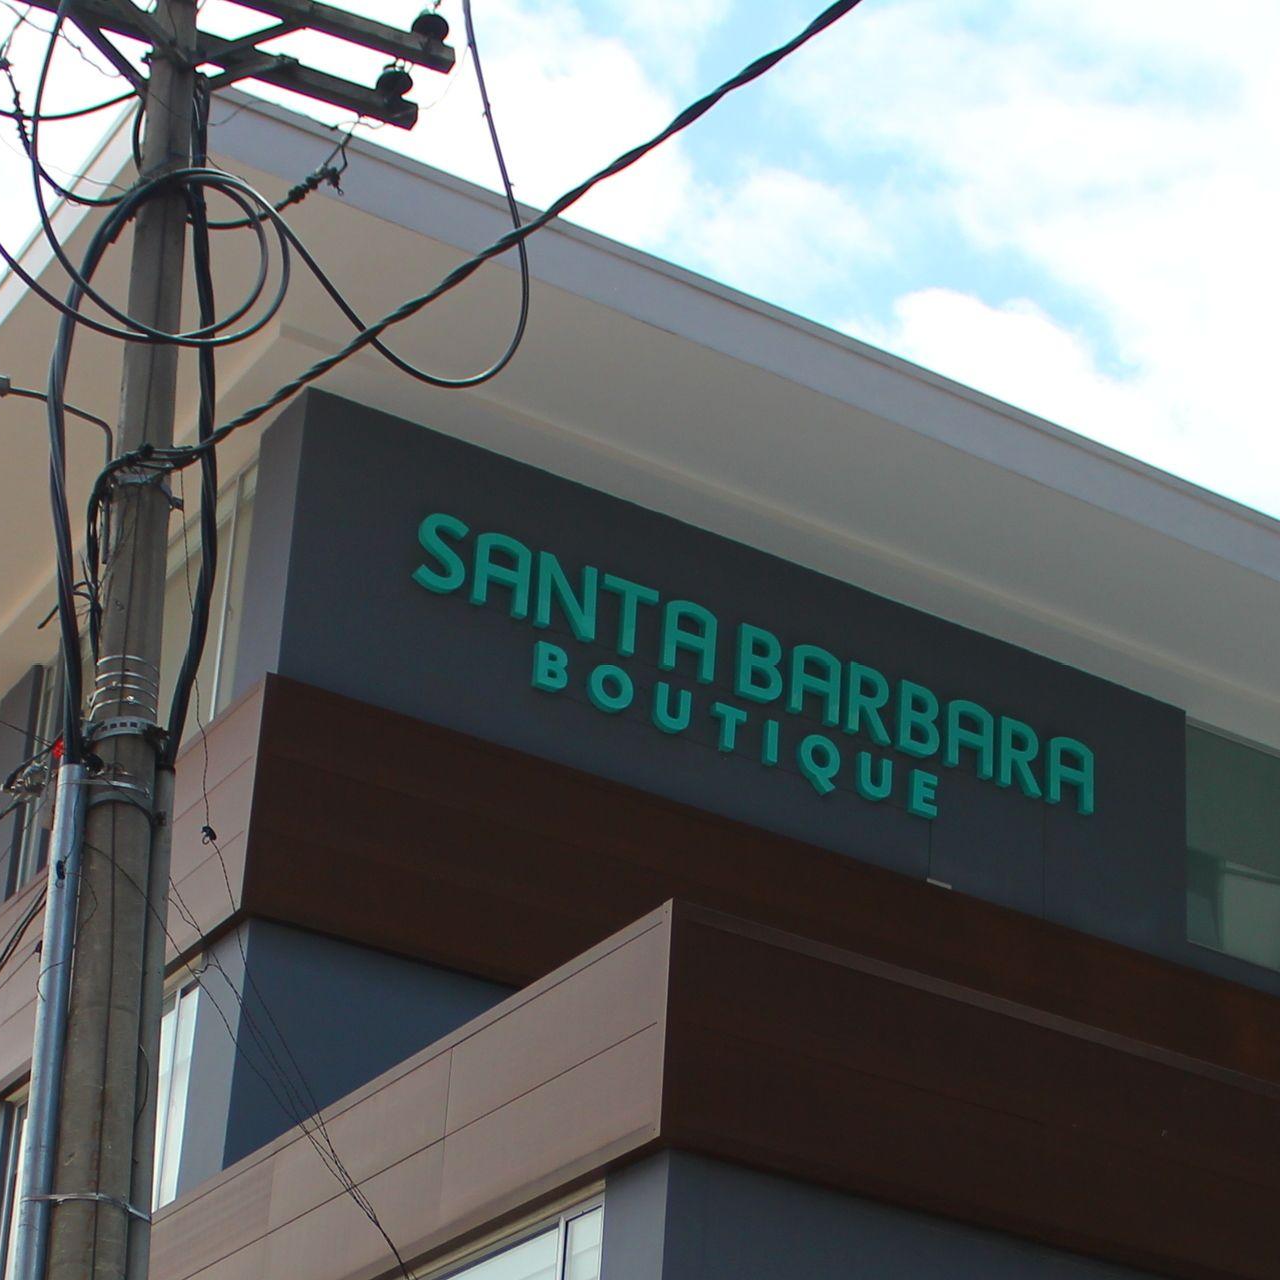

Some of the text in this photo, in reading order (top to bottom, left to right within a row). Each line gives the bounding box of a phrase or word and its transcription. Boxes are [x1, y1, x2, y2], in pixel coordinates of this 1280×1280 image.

[411, 512, 1095, 815] SANTA BARBARA
[532, 640, 938, 819] BOUTIQUE
